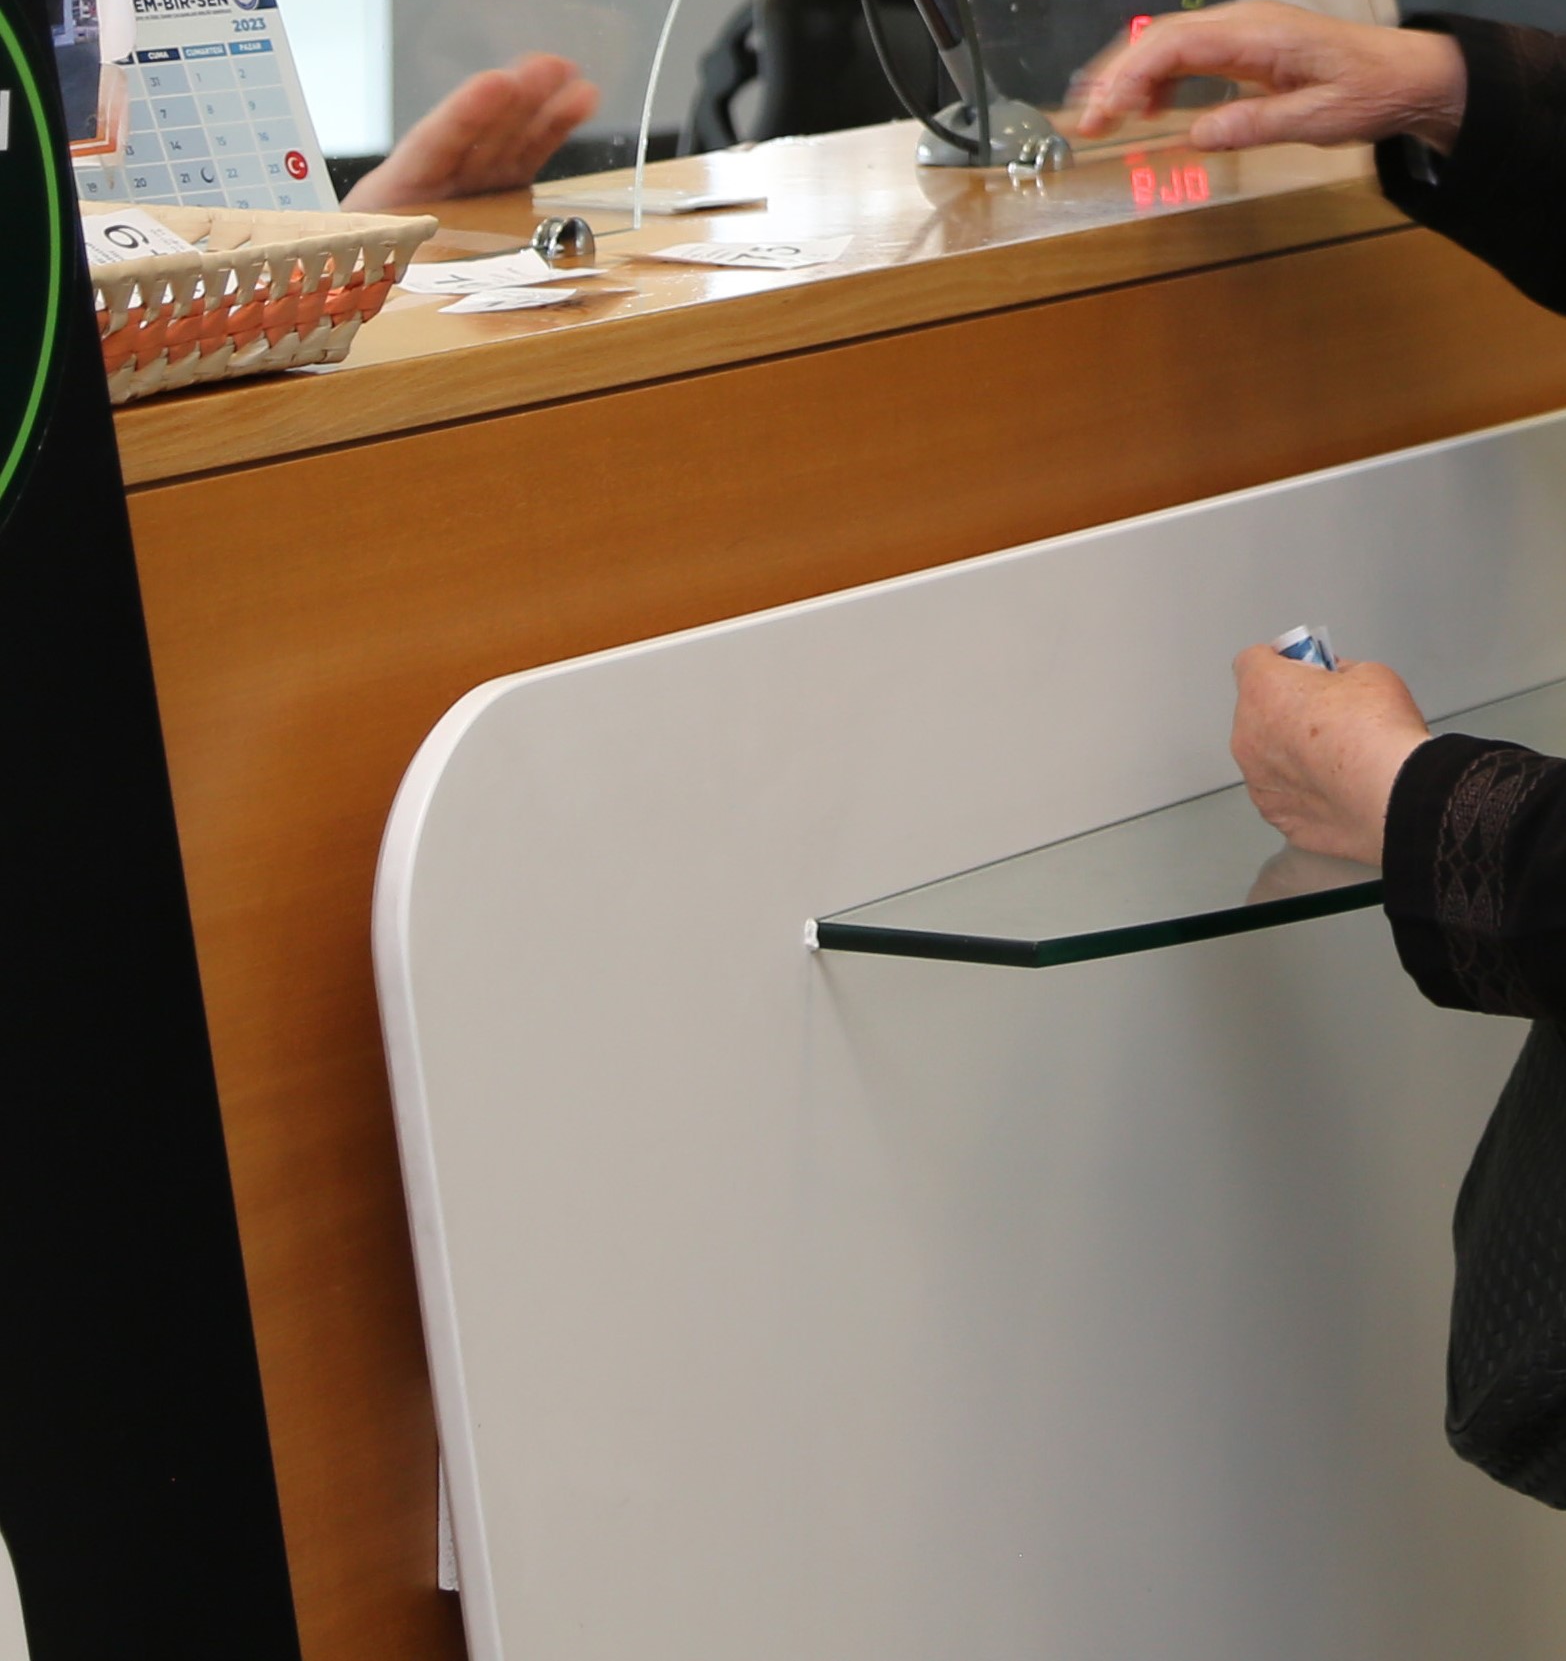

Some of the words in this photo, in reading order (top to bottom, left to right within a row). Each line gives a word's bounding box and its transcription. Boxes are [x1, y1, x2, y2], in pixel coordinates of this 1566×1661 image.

[231, 17, 266, 32] 2023
[148, 51, 169, 59] CUMA
[239, 41, 262, 51] PAZAR
[239, 69, 246, 79] 2
[160, 109, 167, 119] 7
[170, 141, 182, 150] 14
[134, 177, 147, 188] 20
[180, 173, 191, 184] 21
[226, 168, 238, 178] 22
